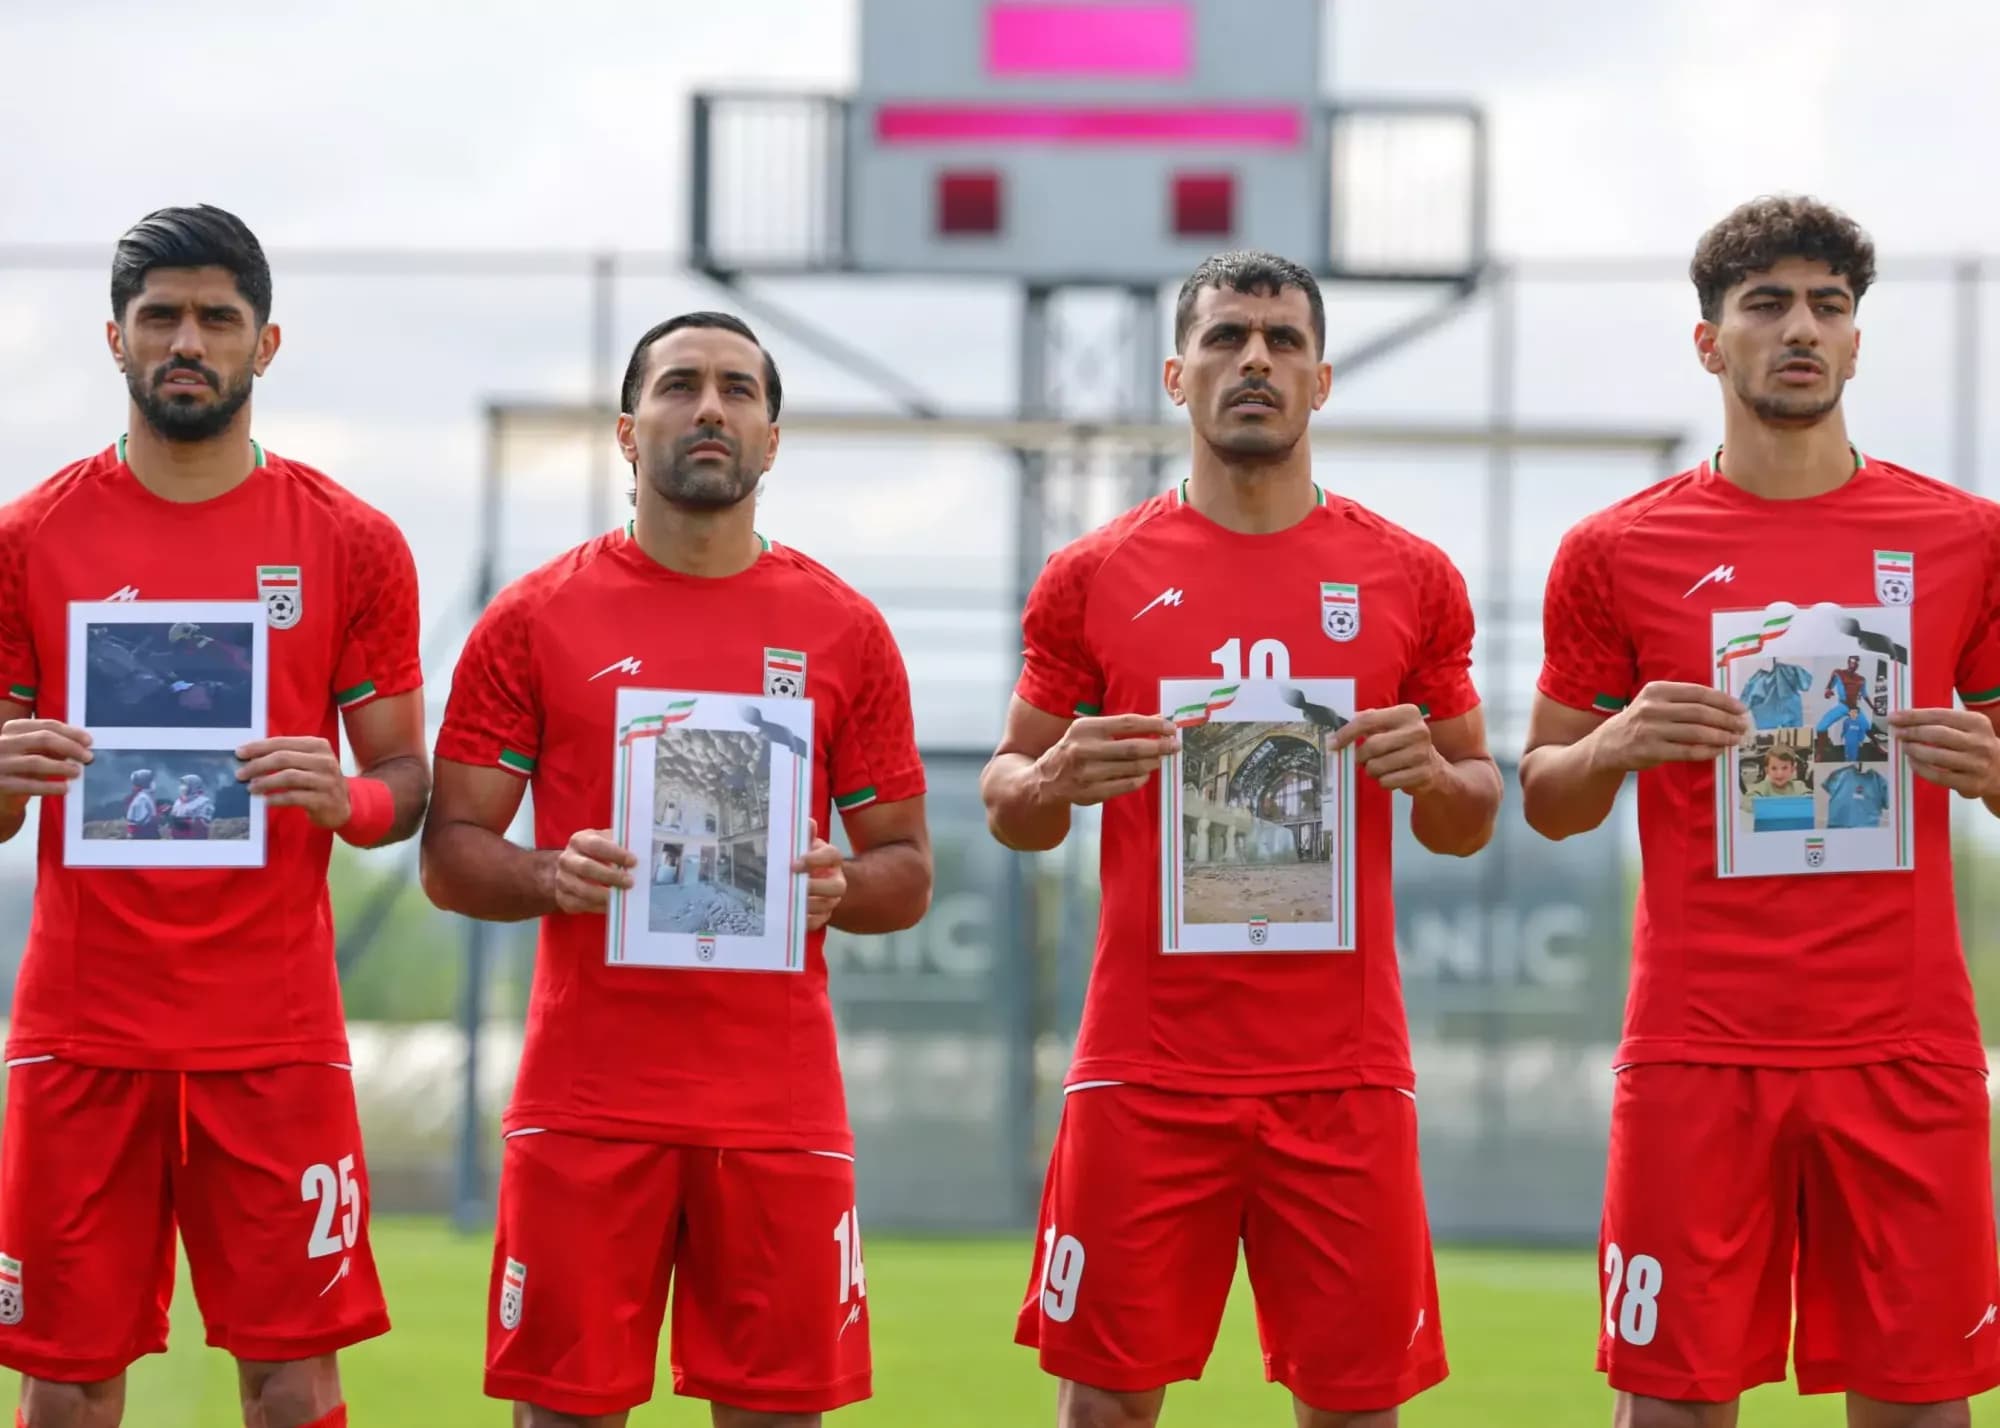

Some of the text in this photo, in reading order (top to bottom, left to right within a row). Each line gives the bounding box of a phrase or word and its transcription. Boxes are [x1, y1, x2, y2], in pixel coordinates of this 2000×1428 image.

[301, 1154, 361, 1259] 25
[834, 1205, 867, 1304] 14
[1040, 1223, 1086, 1323] 19
[1604, 1242, 1663, 1346] 28
